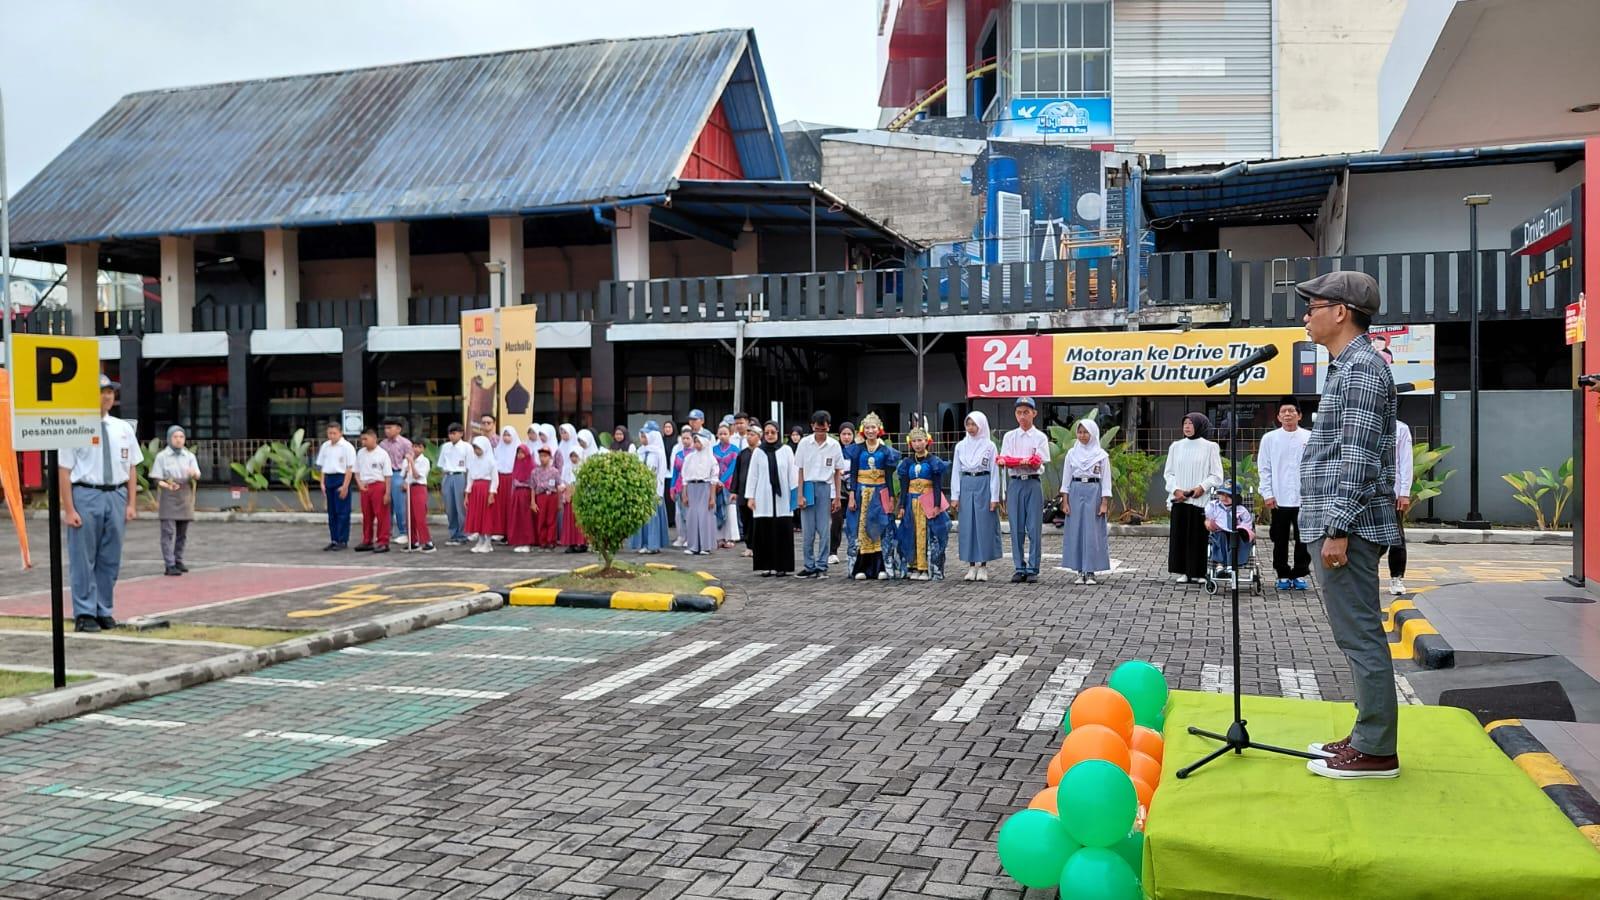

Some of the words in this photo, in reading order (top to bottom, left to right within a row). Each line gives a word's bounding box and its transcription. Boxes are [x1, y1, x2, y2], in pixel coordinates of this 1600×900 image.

[1524, 218, 1545, 245] Drive
[1544, 206, 1563, 233] Thru
[468, 336, 492, 347] Choco
[467, 348, 494, 359] Banana
[983, 339, 1033, 371] 24
[1066, 347, 1143, 362] Motoran
[1147, 345, 1169, 361] ke
[1173, 343, 1224, 360] Drive
[1229, 343, 1264, 359] Th
[36, 346, 78, 402] P
[475, 360, 486, 370] Pie
[979, 371, 1036, 393] Jam
[1072, 365, 1146, 386] Banyak
[1151, 364, 1266, 384] Untunya
[40, 417, 77, 425] Khusus
[21, 427, 64, 438] pesanan
[66, 426, 96, 435] online
